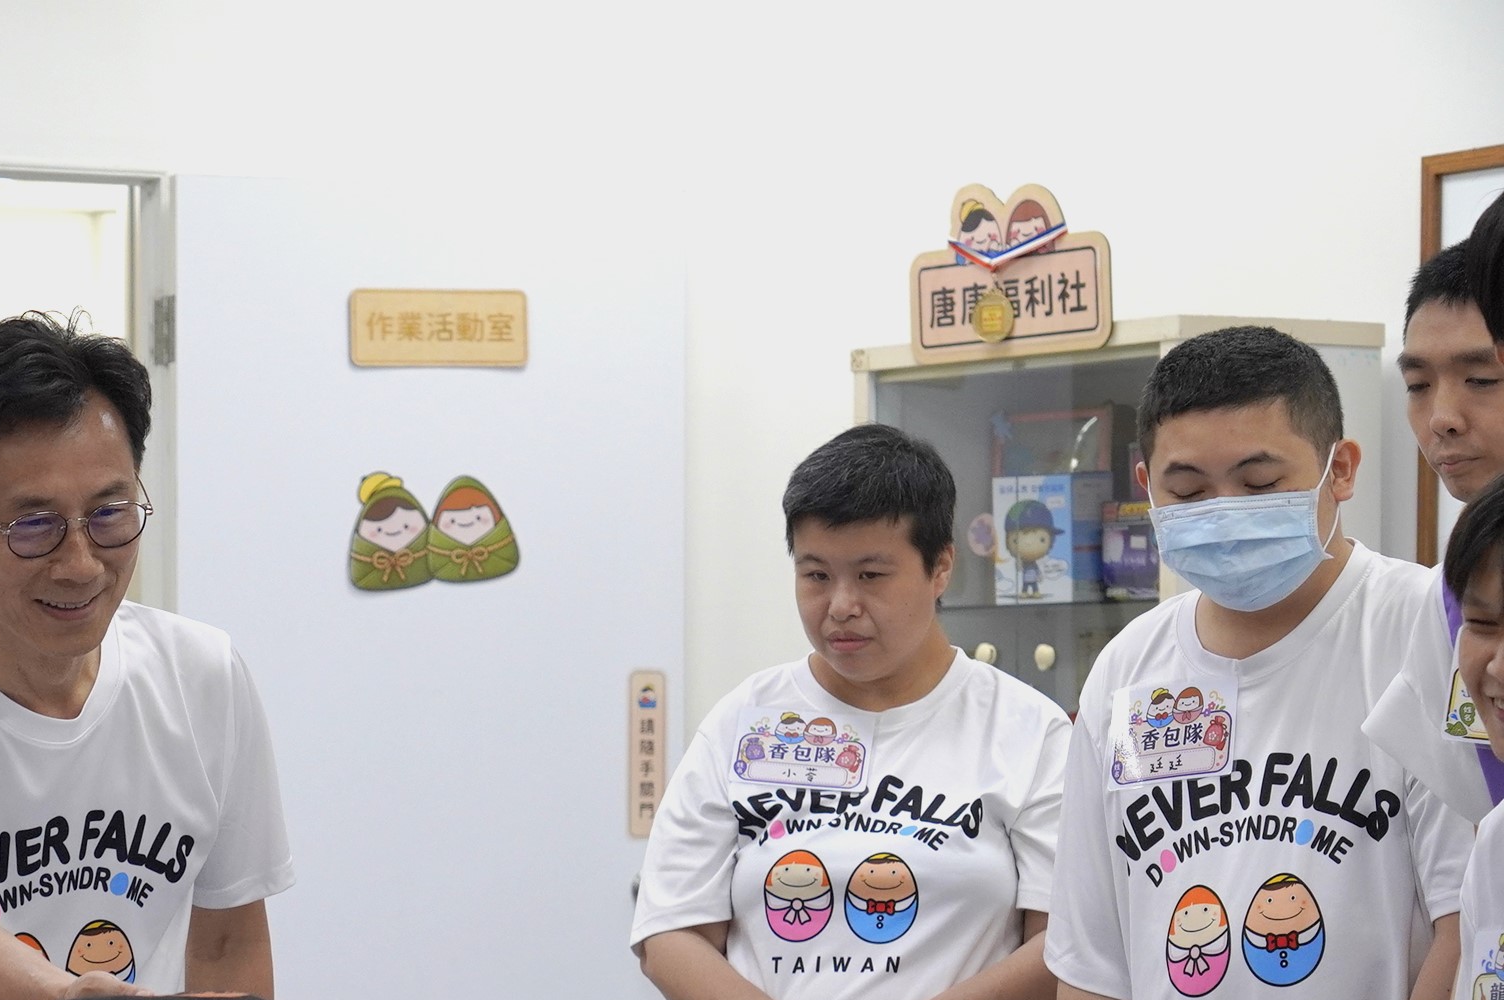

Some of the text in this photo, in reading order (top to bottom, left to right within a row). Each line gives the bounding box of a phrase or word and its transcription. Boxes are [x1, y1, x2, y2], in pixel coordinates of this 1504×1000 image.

[366, 312, 515, 343] 作業活動室
[769, 743, 836, 763] 香包隊
[1141, 722, 1204, 751] 香包隊
[871, 775, 983, 838] FALLS
[1259, 753, 1400, 842] FALLS
[79, 810, 194, 883] FALLS
[1146, 814, 1354, 888] DOWN-SYNDROME
[772, 956, 901, 974] TAIWAN
